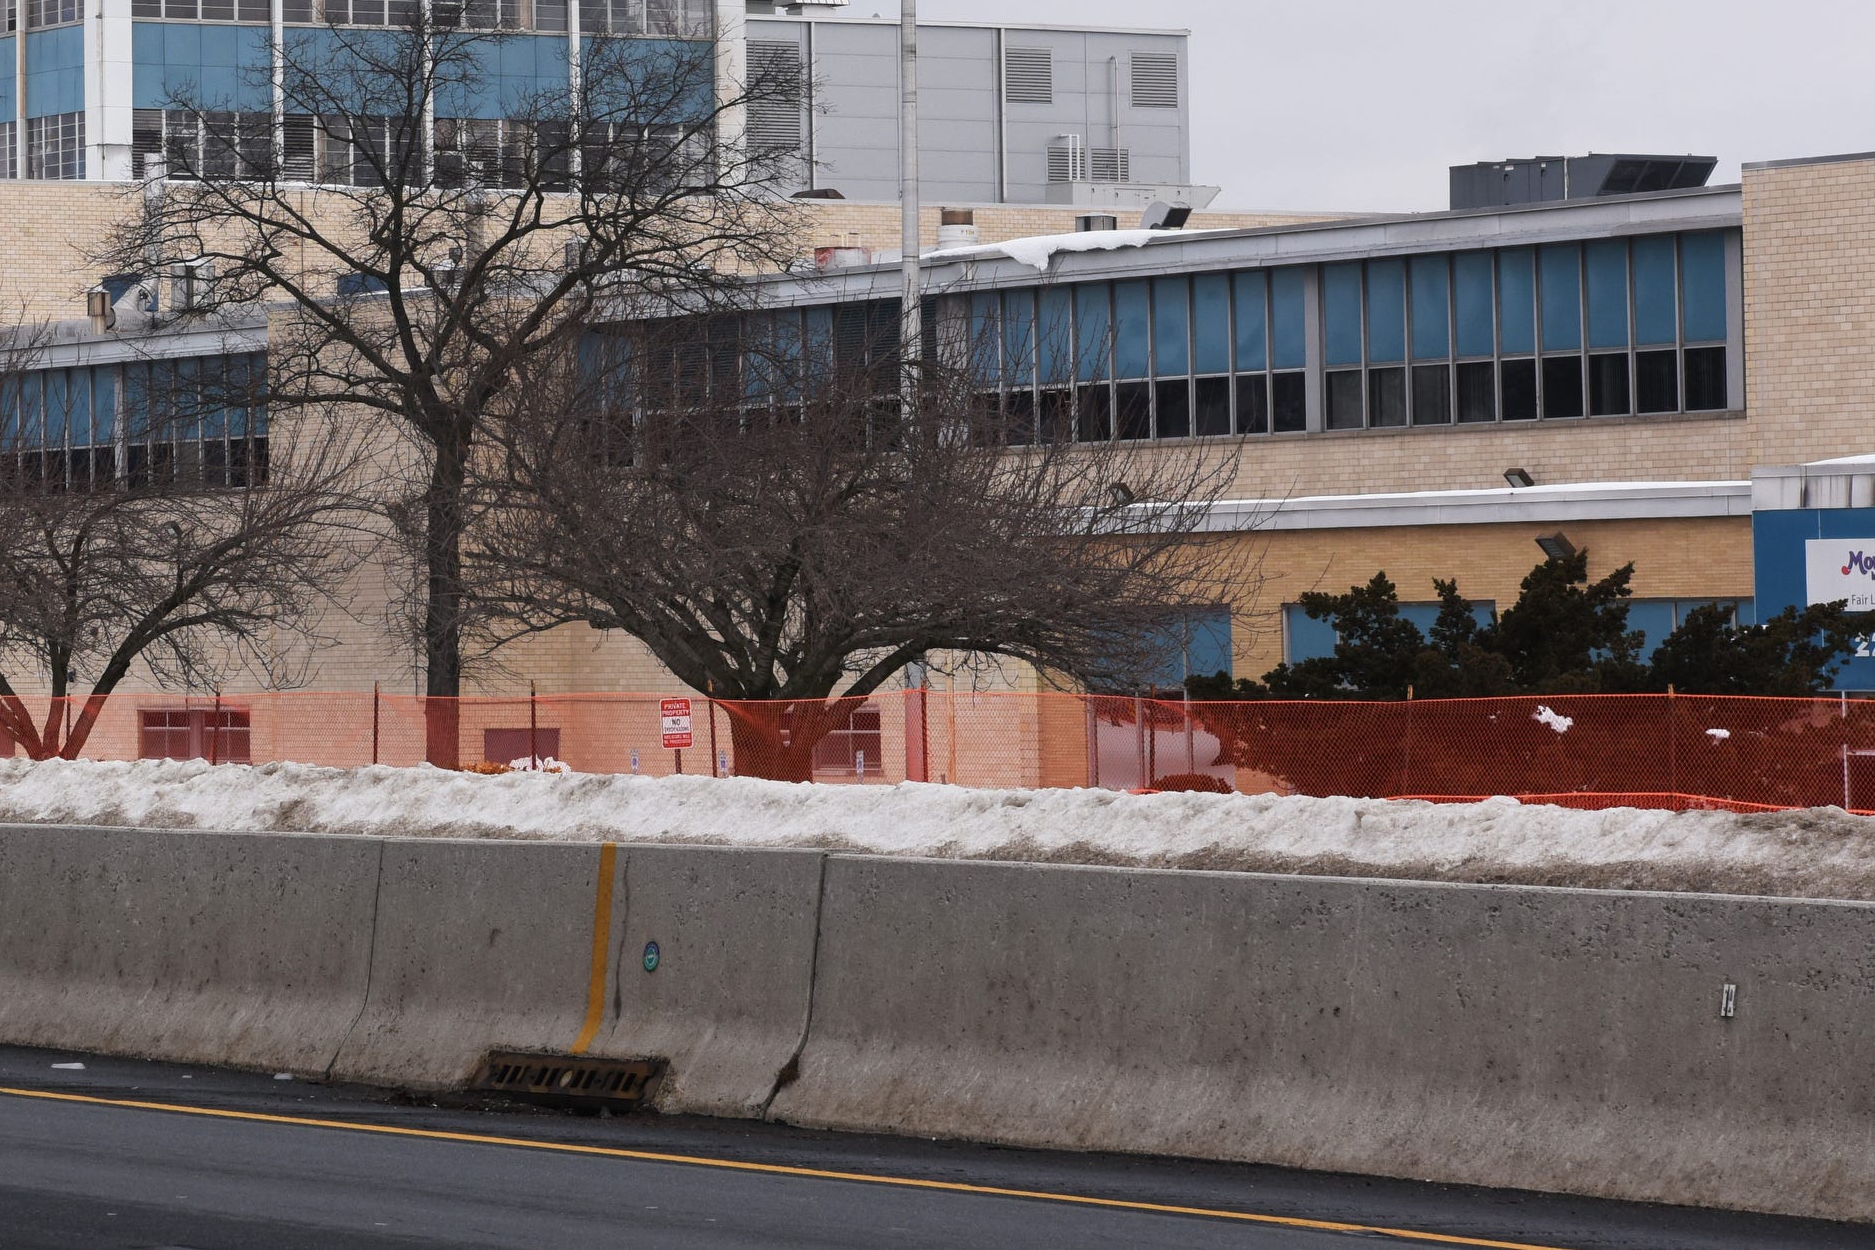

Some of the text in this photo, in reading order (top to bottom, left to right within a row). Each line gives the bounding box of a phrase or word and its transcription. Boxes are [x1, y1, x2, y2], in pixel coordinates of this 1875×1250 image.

[1843, 550, 1875, 575] Mo
[1851, 594, 1869, 605] Fair
[1854, 631, 1875, 657] 2
